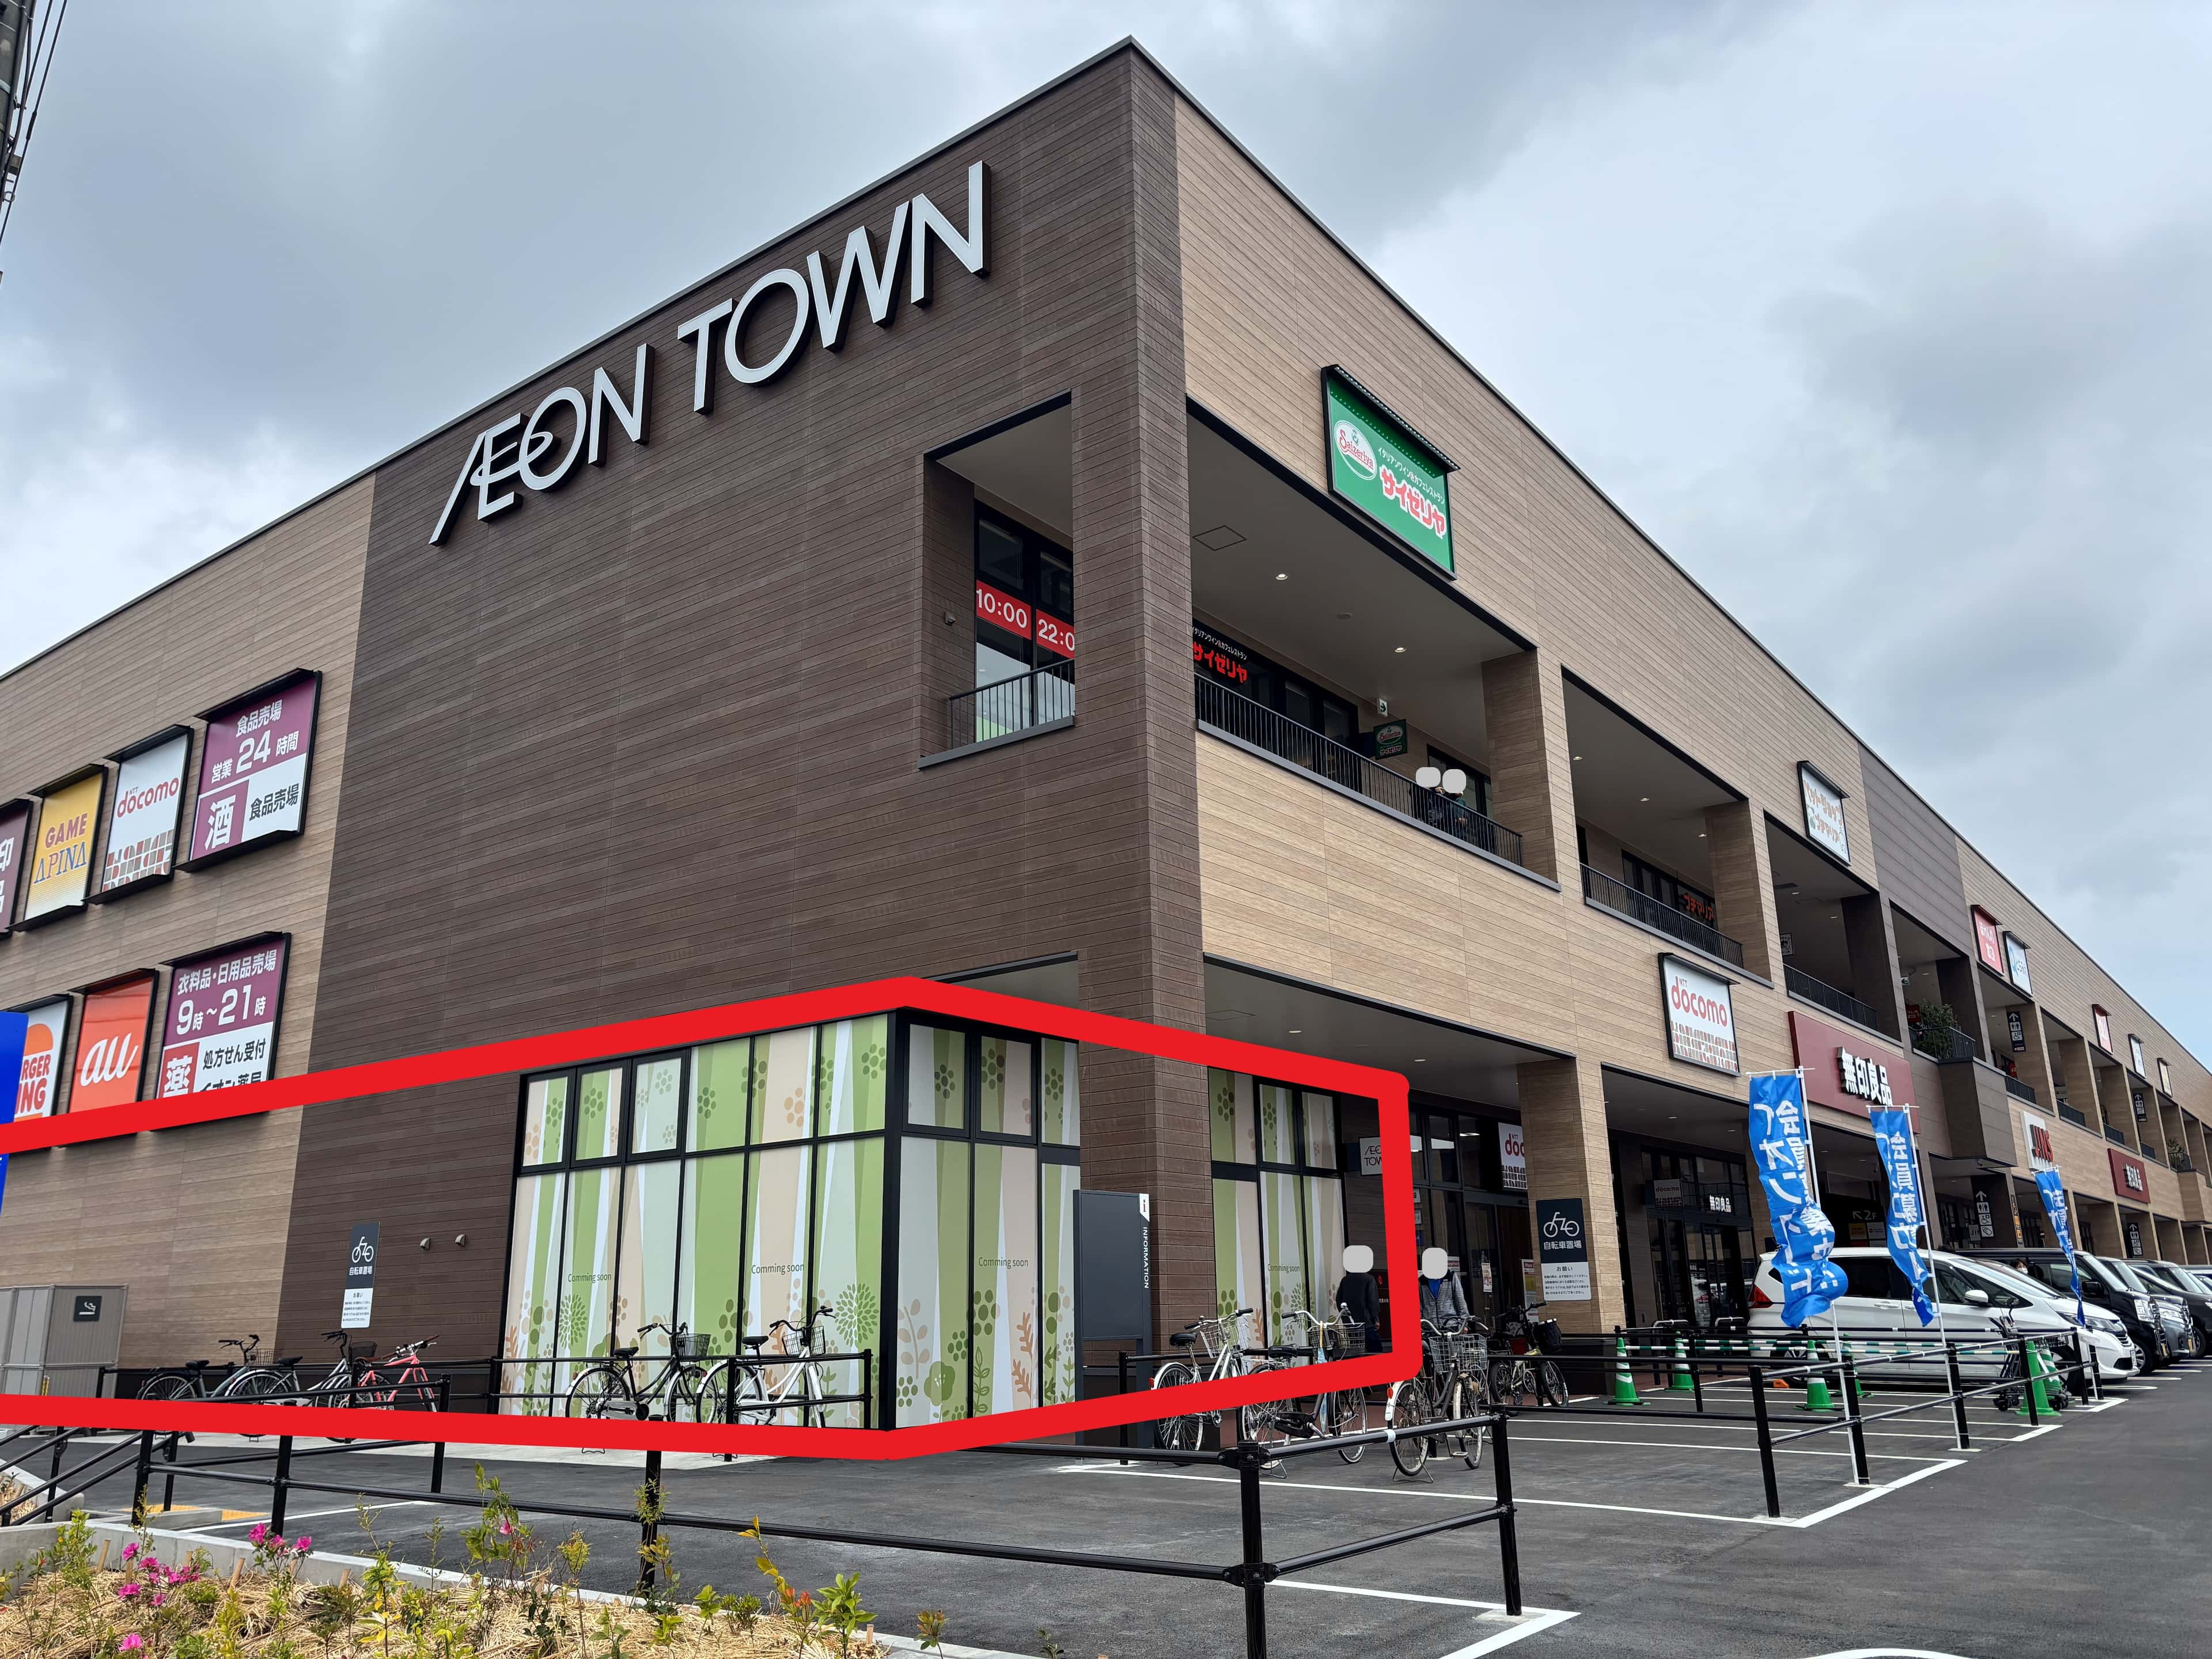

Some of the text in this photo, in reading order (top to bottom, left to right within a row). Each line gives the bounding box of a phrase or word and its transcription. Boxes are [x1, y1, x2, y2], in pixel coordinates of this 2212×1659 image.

[678, 160, 990, 414] TOWN
[1339, 429, 1374, 470] Saizeriya
[1380, 465, 1446, 538] サイゼリヤ
[976, 589, 1075, 652] 10:00 22:0
[1193, 641, 1248, 684] サイゼリヤ
[236, 699, 282, 738] 食品売場
[211, 729, 300, 784] 営業 24 時間
[117, 777, 179, 819] docomo
[249, 782, 300, 821] 食品売場
[45, 812, 88, 849] GAME
[204, 794, 236, 851] 酒
[177, 949, 277, 996] 衣料品・日用品売場
[1672, 976, 1728, 1027] docomo
[21, 1054, 51, 1082] RGER
[80, 1032, 139, 1087] au
[202, 1037, 267, 1070] 処方せん受付
[163, 1055, 193, 1098] 薬
[1840, 1046, 1893, 1107] 無印良品
[2030, 1124, 2054, 1162] JINS
[1709, 1194, 1732, 1213] 無印良品
[1863, 1210, 1877, 1221] 2F
[978, 1256, 1012, 1270] Comming
[1543, 1240, 1582, 1250] 自転車置場
[567, 1272, 612, 1284] Comming soon
[751, 1263, 805, 1275] Comming soon
